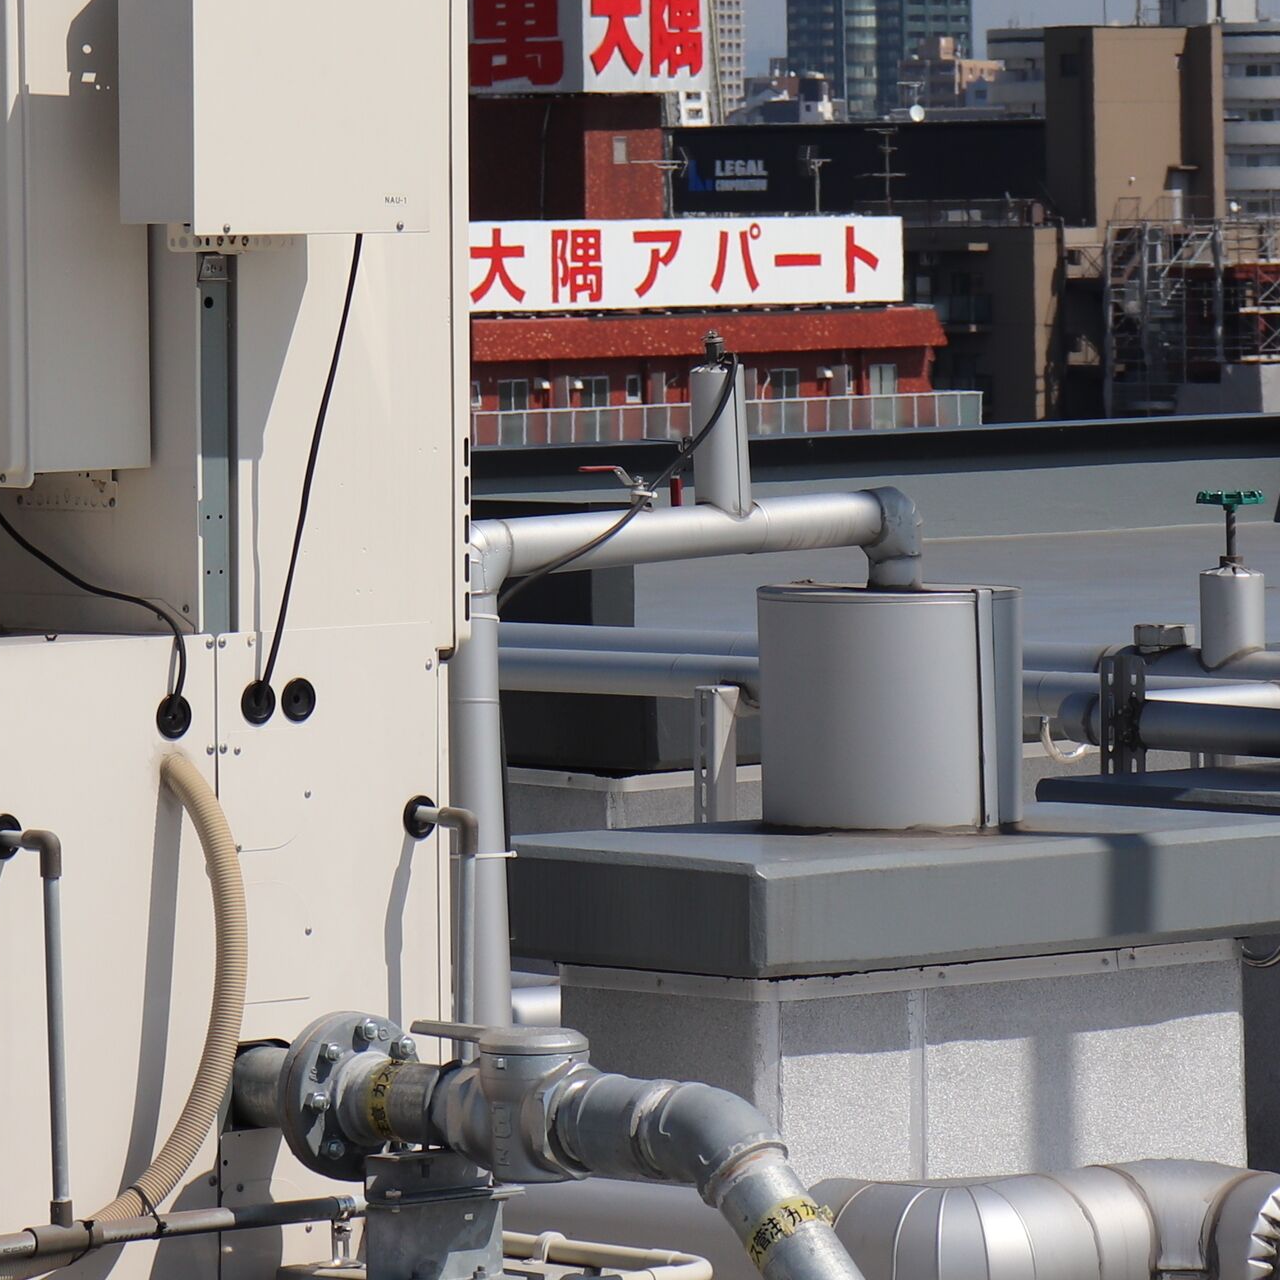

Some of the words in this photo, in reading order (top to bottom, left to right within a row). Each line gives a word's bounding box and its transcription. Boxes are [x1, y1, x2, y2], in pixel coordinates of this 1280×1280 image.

[715, 159, 768, 177] LEGAL
[384, 196, 407, 205] NAU-1
[470, 222, 880, 304] 大隅アパート
